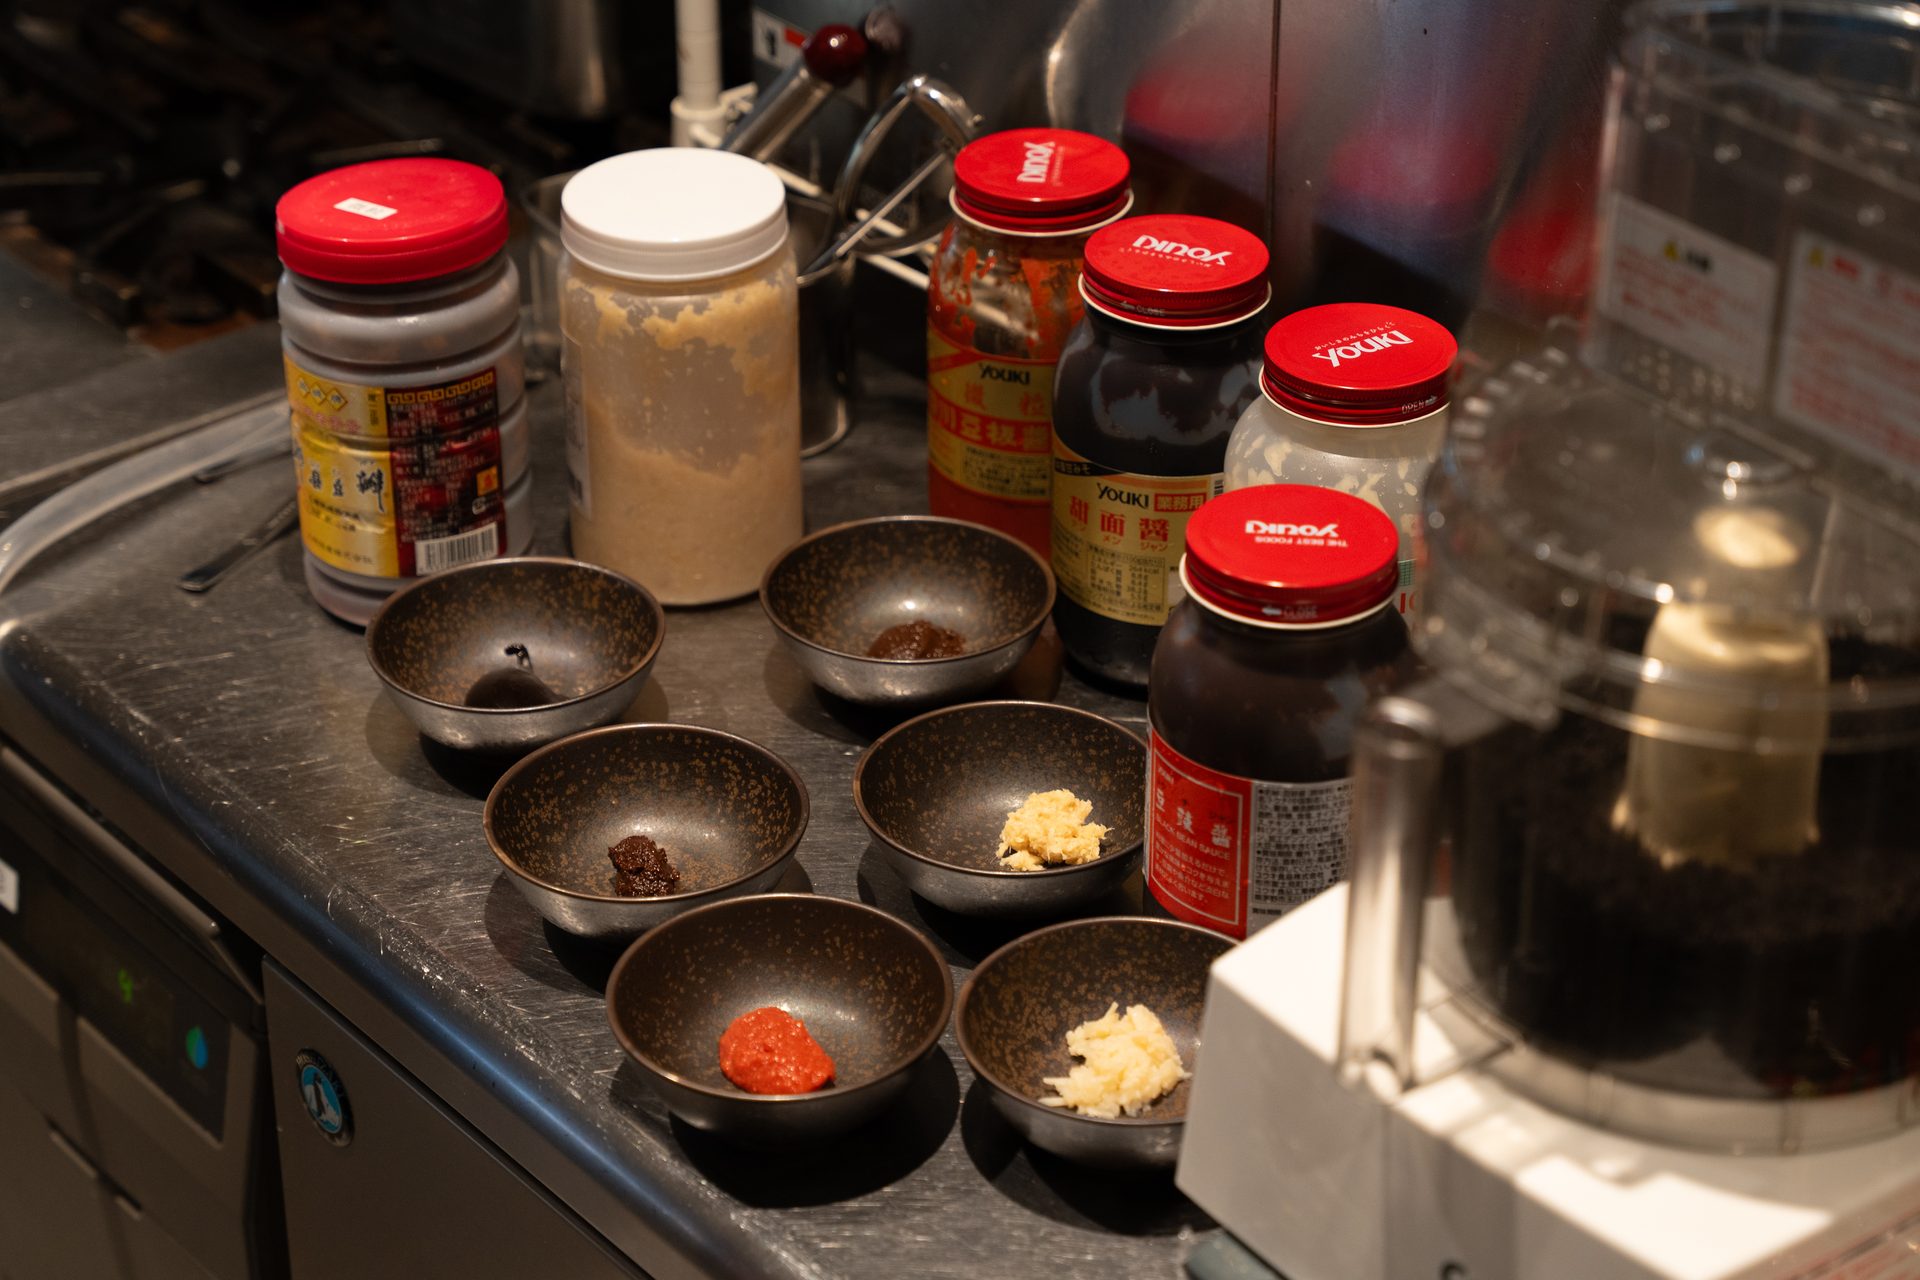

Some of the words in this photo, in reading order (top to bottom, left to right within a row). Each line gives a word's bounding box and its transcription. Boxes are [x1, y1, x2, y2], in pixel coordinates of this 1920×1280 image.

[1132, 234, 1233, 266] YOUKI
[1312, 330, 1414, 368] YOUKI
[978, 363, 1031, 386] YOUKI
[1402, 400, 1425, 415] OPEN
[1096, 482, 1150, 509] YOUKI
[1245, 520, 1339, 538] YOUKI
[1254, 536, 1293, 545] FOODS
[1297, 537, 1324, 546] BEST
[1327, 538, 1348, 548] THE
